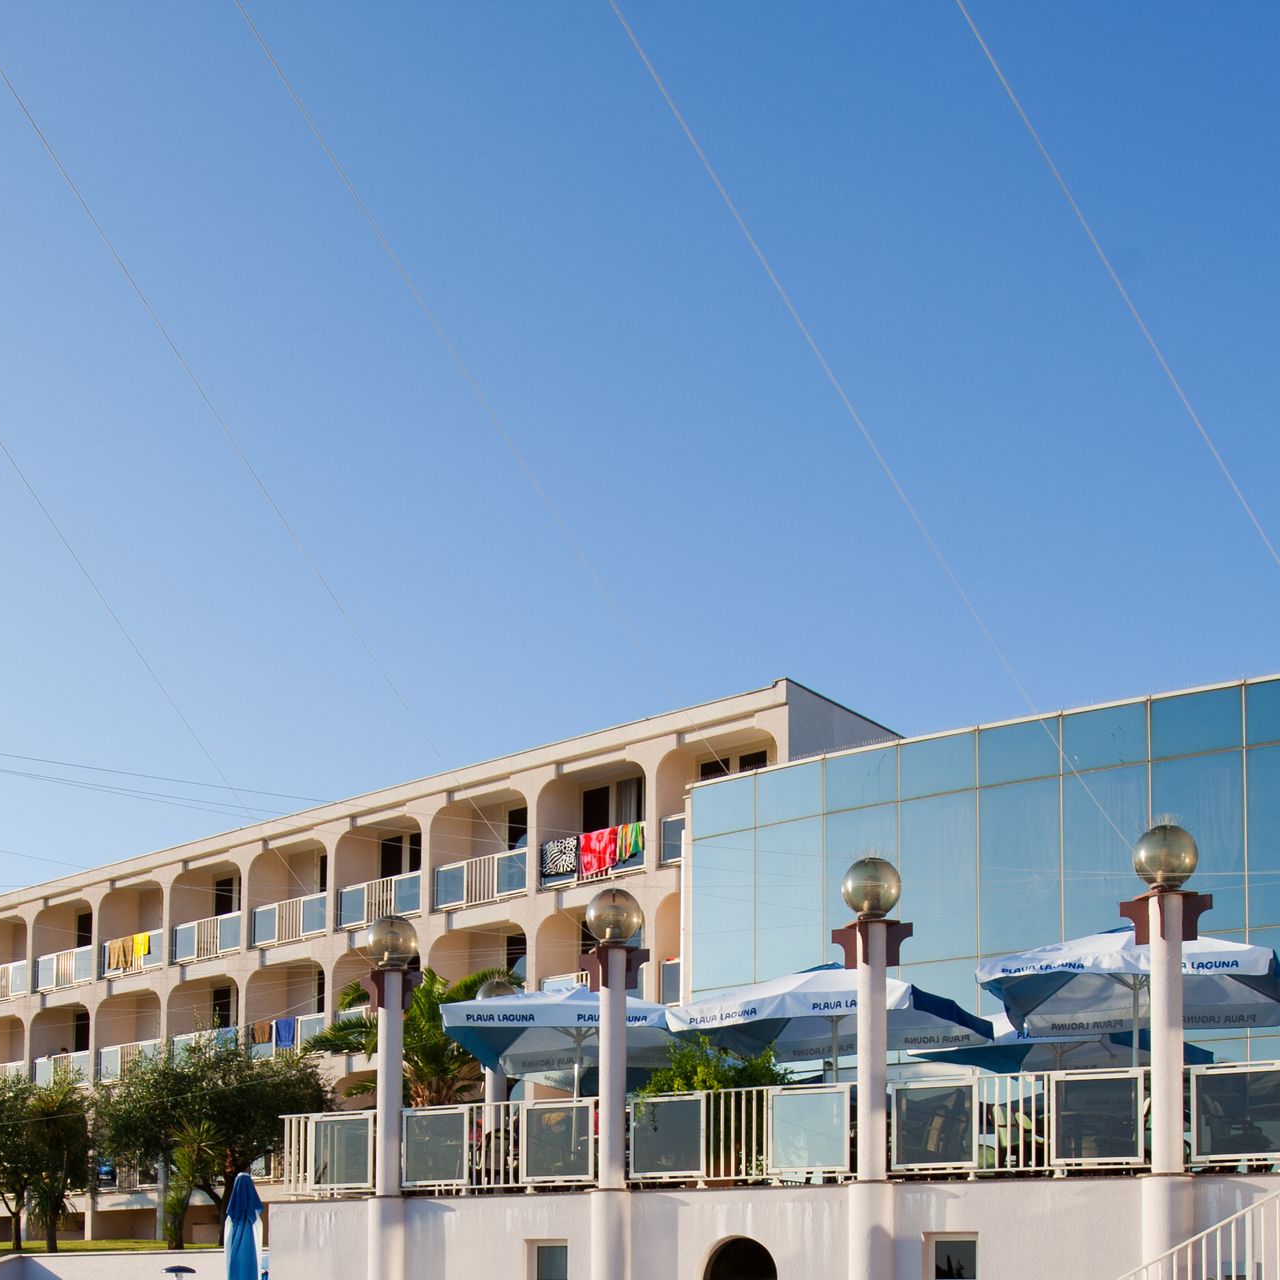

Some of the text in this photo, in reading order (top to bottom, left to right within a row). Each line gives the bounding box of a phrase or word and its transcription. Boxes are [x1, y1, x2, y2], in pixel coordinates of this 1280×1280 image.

[1191, 960, 1239, 970] LAGUNA
[497, 1013, 535, 1022] LAGUNA
[577, 1013, 600, 1022] PLAV
[720, 1007, 757, 1020] LAGUNA
